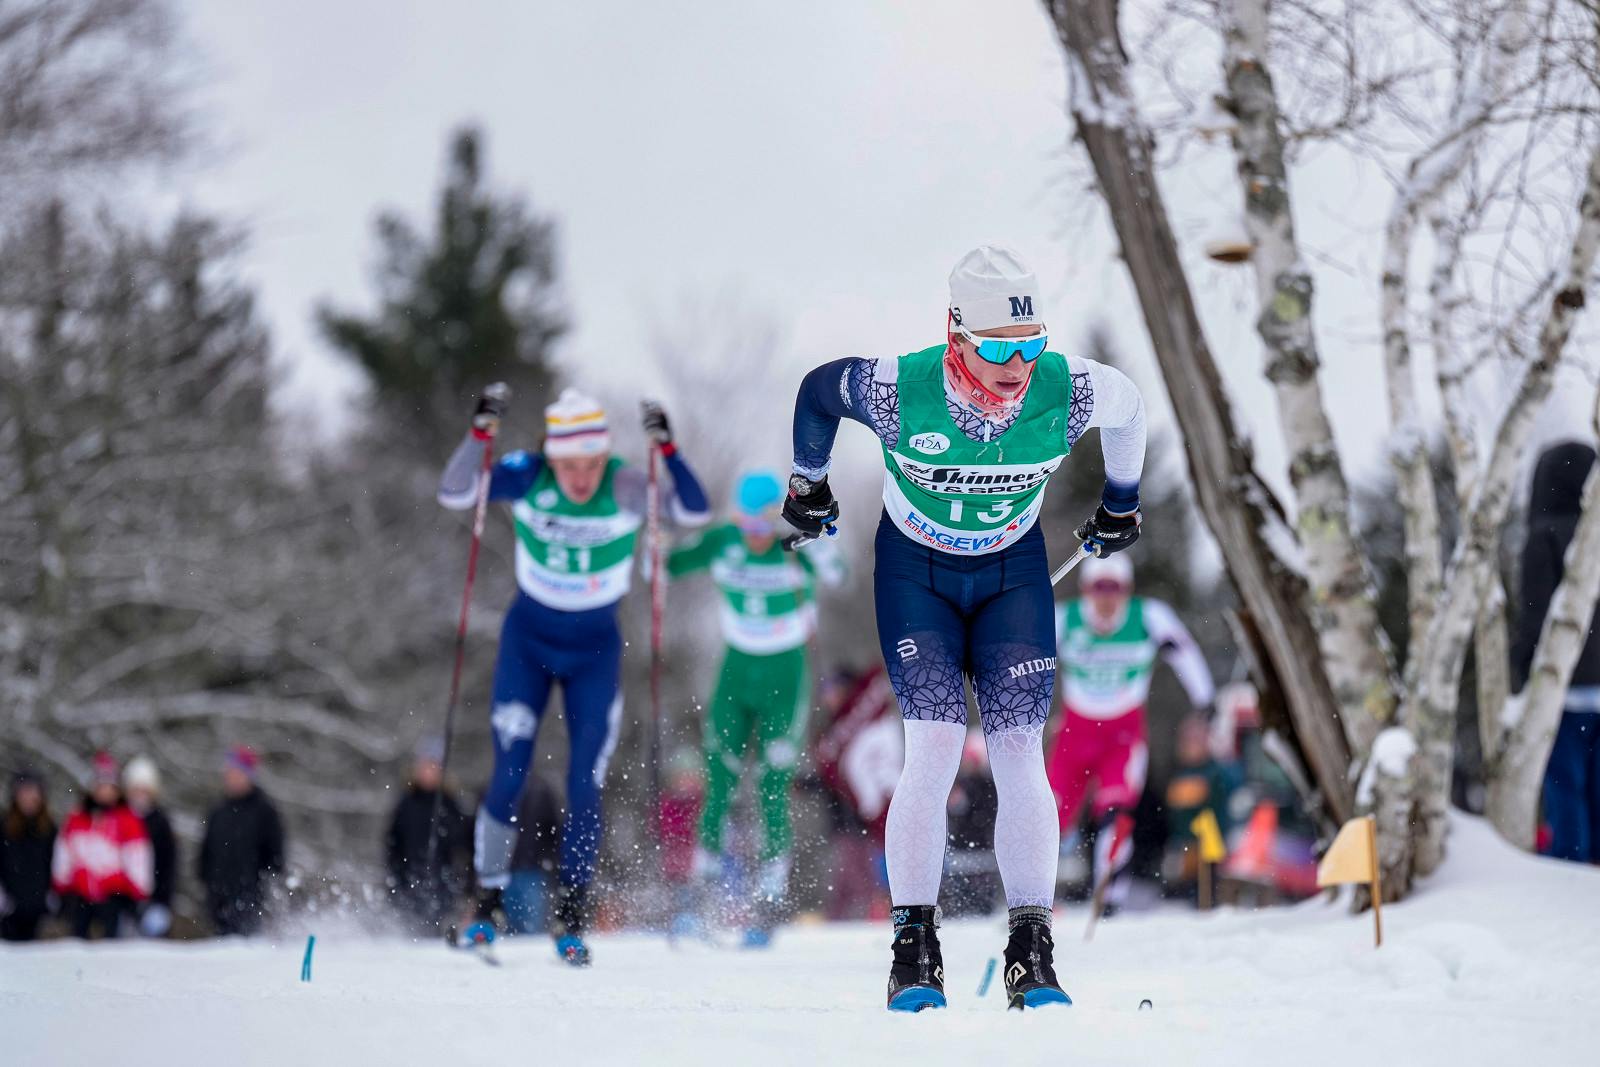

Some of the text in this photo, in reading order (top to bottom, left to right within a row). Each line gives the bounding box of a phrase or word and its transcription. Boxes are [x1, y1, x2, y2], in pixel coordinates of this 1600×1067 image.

[1008, 296, 1034, 317] M
[968, 479, 1043, 494] SPOR
[940, 498, 1014, 524] 13
[1008, 656, 1057, 679] MIDDL
